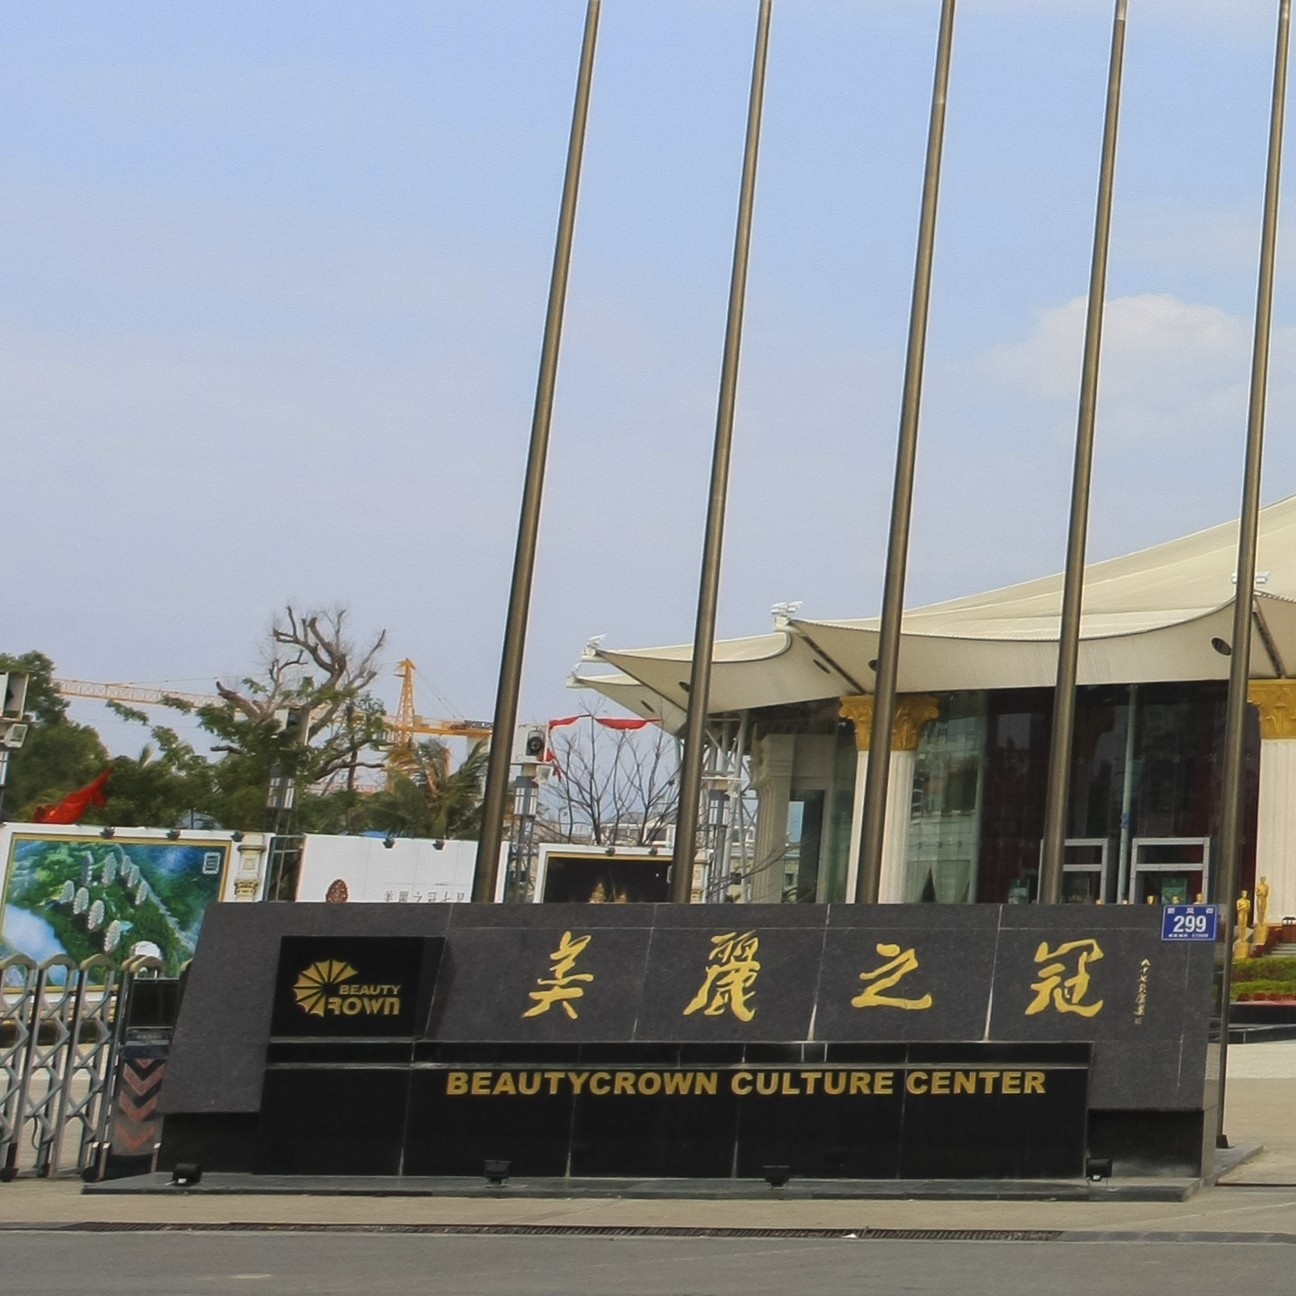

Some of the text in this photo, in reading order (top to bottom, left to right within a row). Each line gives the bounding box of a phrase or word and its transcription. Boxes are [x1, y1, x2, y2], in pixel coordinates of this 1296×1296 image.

[1172, 915, 1207, 933] 299
[339, 984, 400, 995] BEAUTY
[446, 1070, 1047, 1096] BEAUTYCROWN CULTURE CENTER
